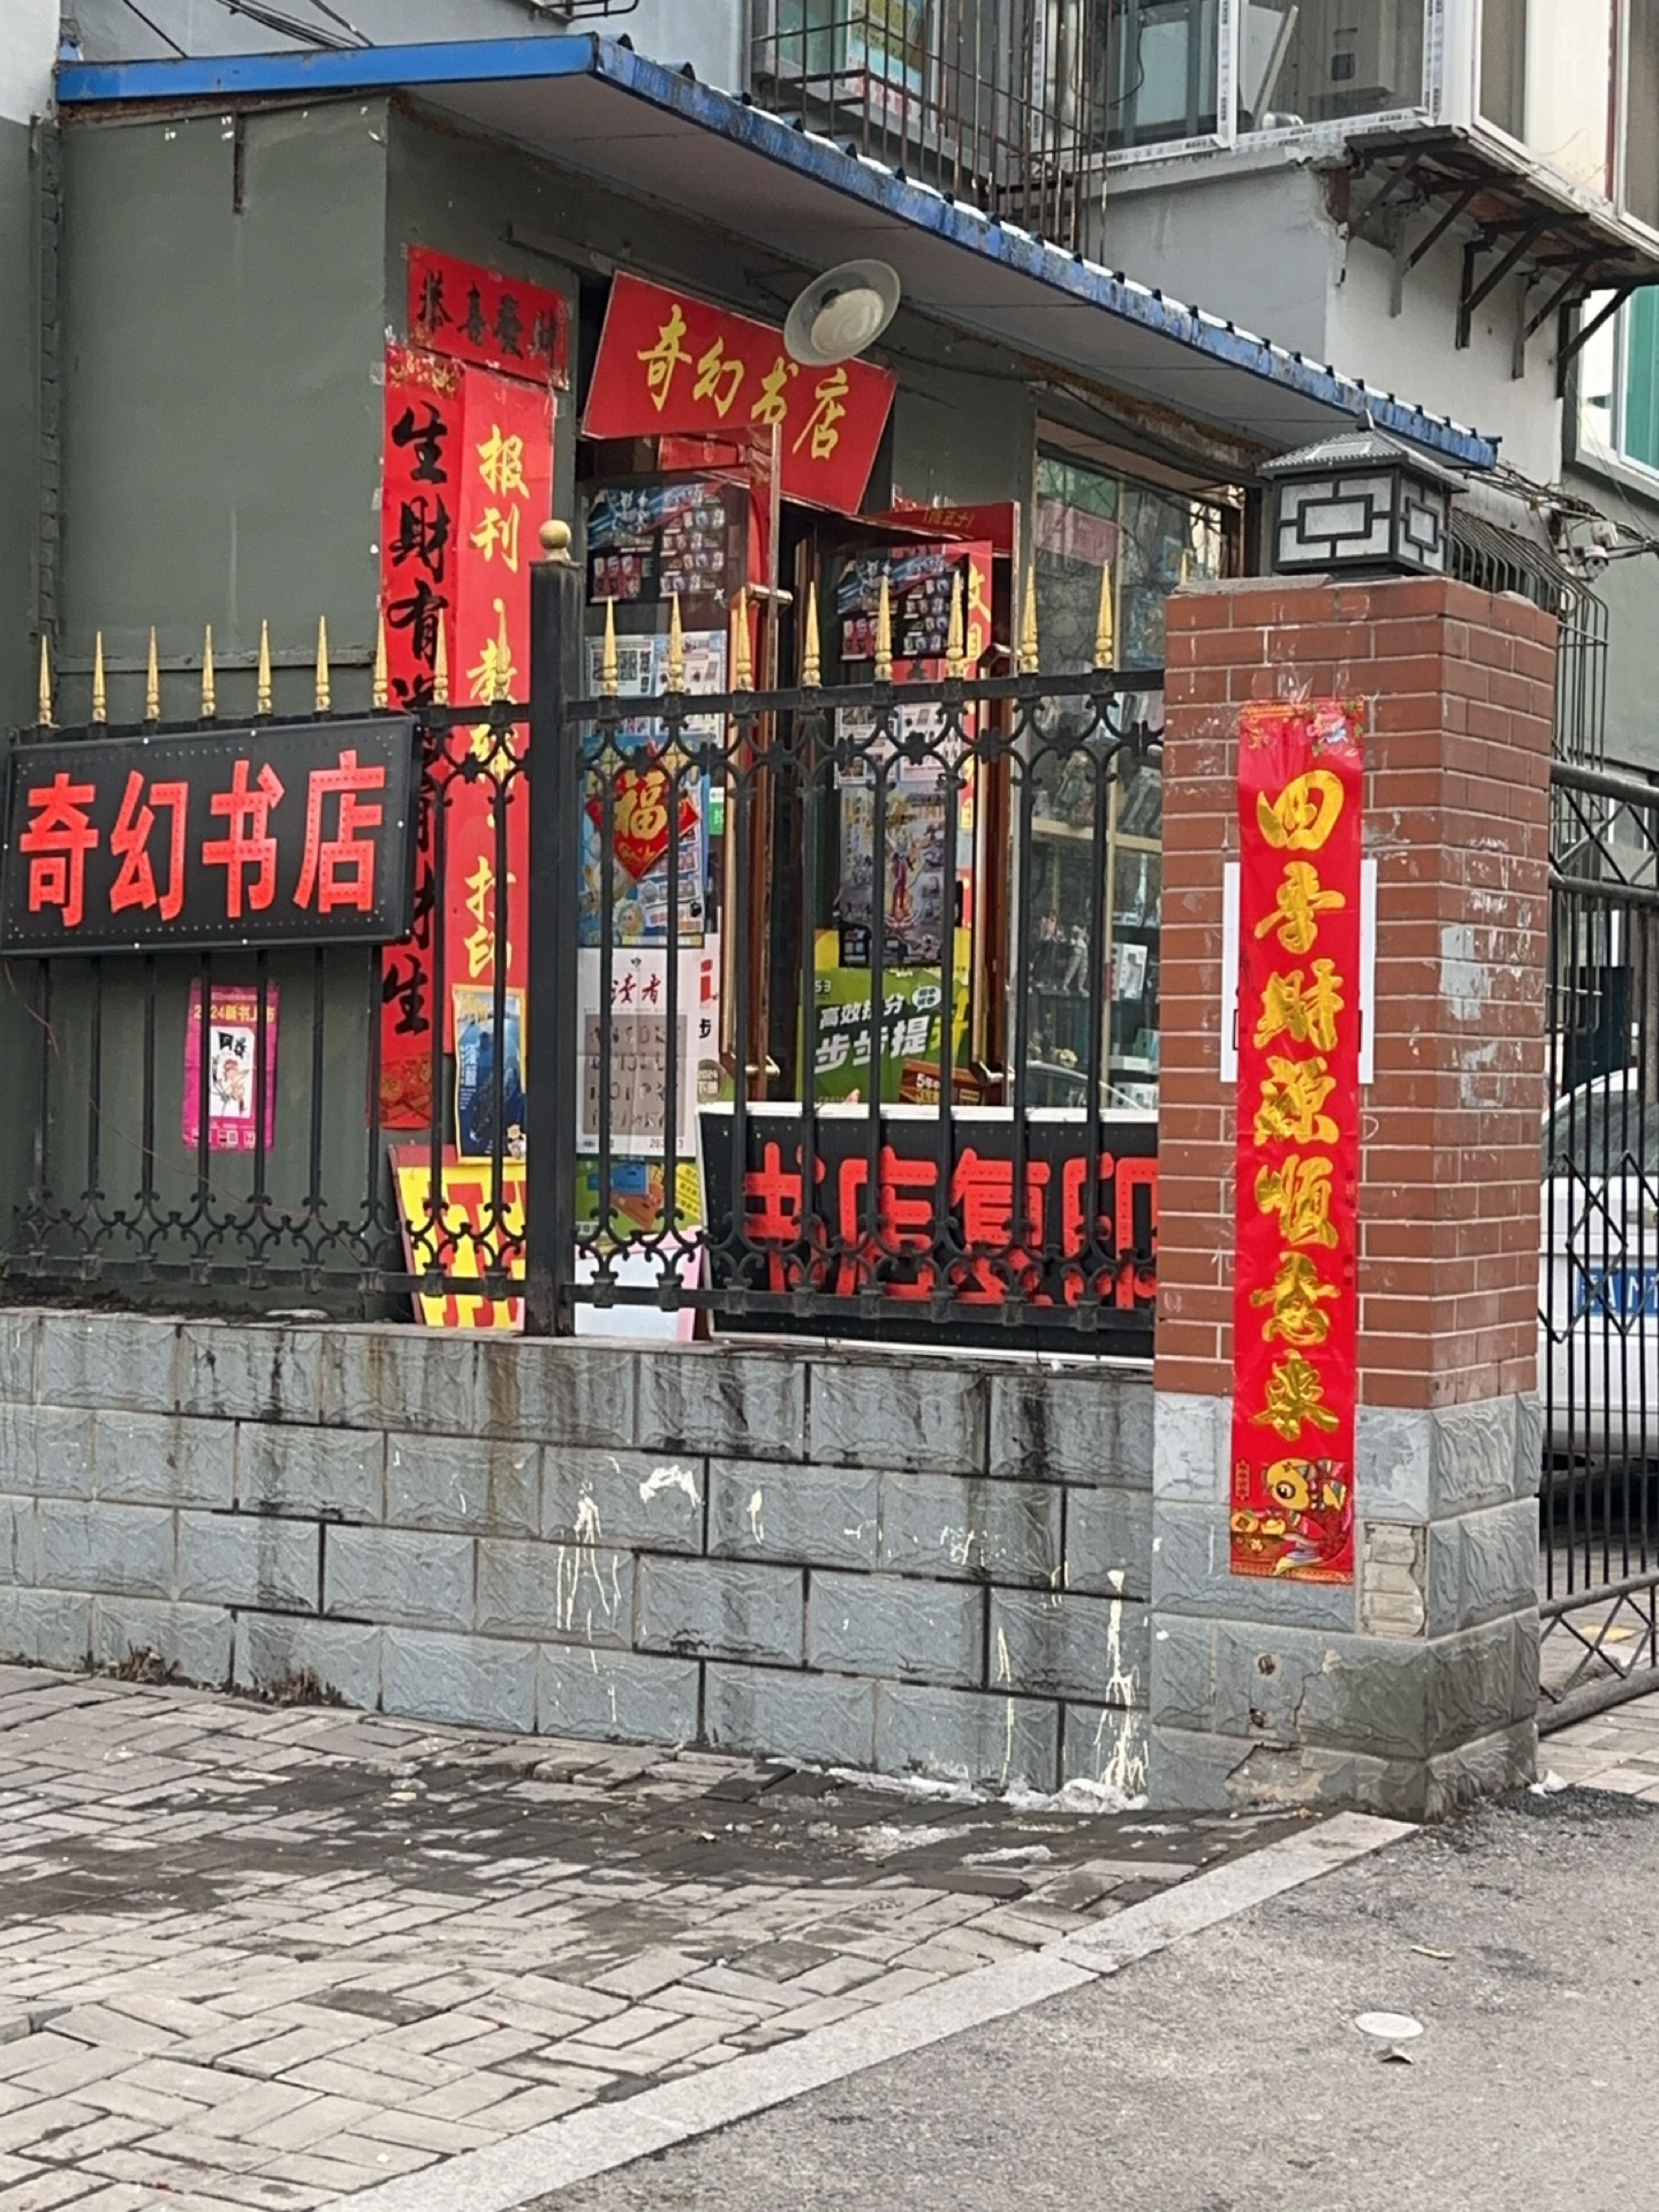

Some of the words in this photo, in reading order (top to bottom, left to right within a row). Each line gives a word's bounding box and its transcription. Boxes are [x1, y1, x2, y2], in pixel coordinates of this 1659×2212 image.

[636, 303, 849, 460] 奇幻书店
[19, 749, 385, 927] 奇幻书店
[613, 768, 668, 840] 福
